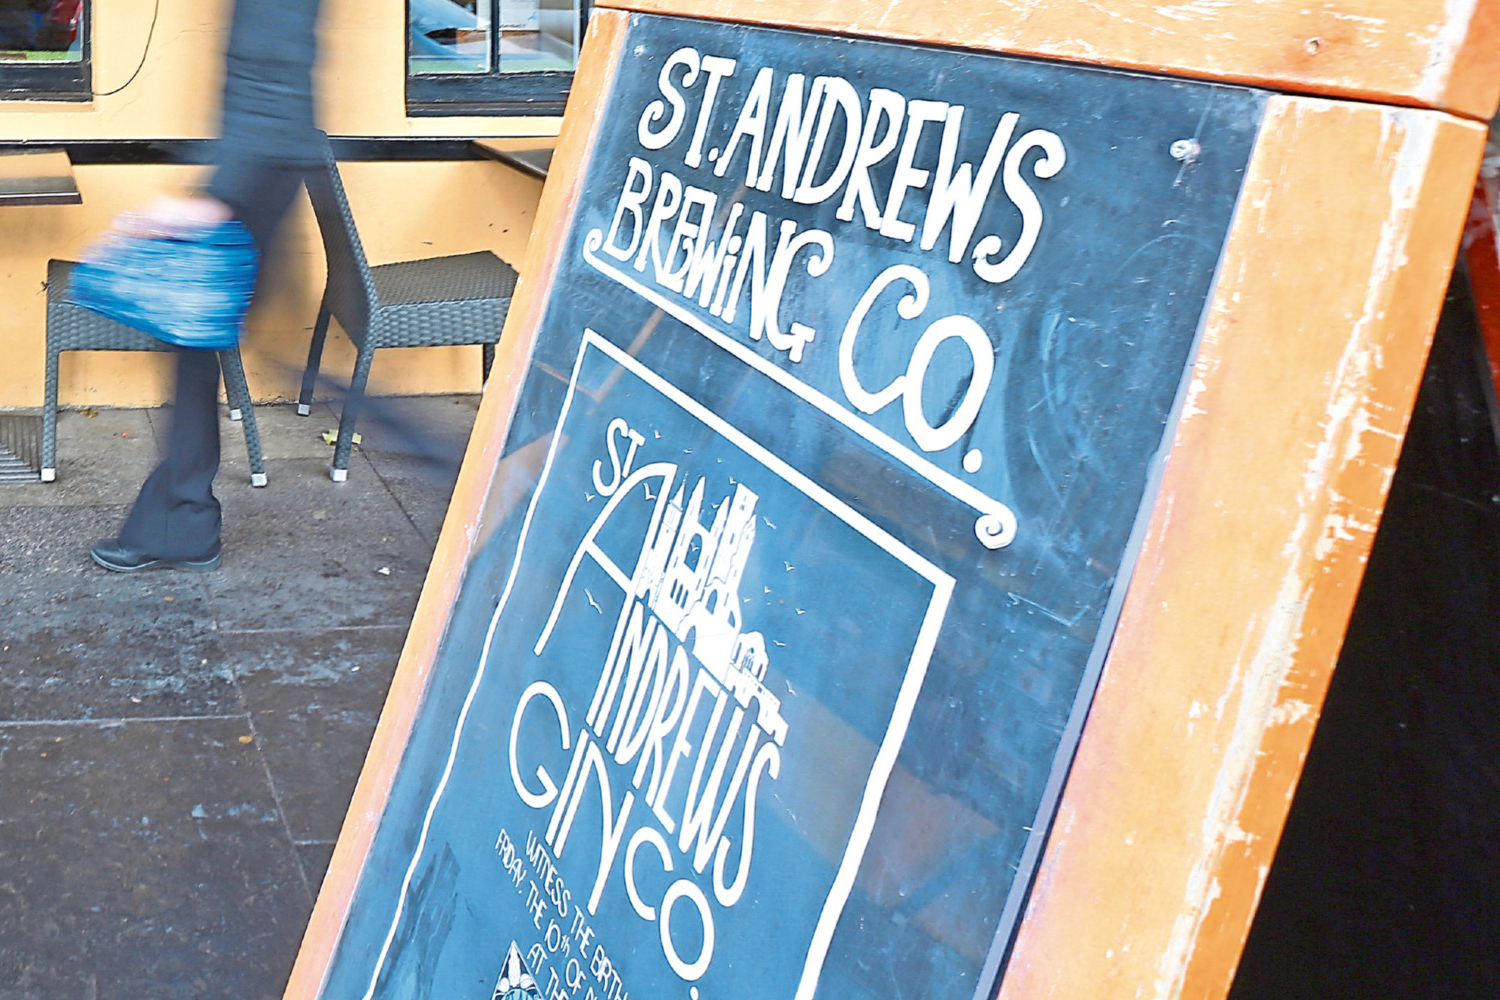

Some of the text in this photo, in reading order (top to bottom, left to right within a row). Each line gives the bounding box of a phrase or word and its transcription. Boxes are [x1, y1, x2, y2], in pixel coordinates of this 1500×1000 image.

[592, 416, 646, 496] ST
[508, 680, 635, 917] GIN
[525, 880, 548, 930] THE
[565, 958, 586, 995] OF
[526, 830, 571, 918] WITNESS
[570, 904, 595, 959] THE
[526, 942, 548, 975] AT
